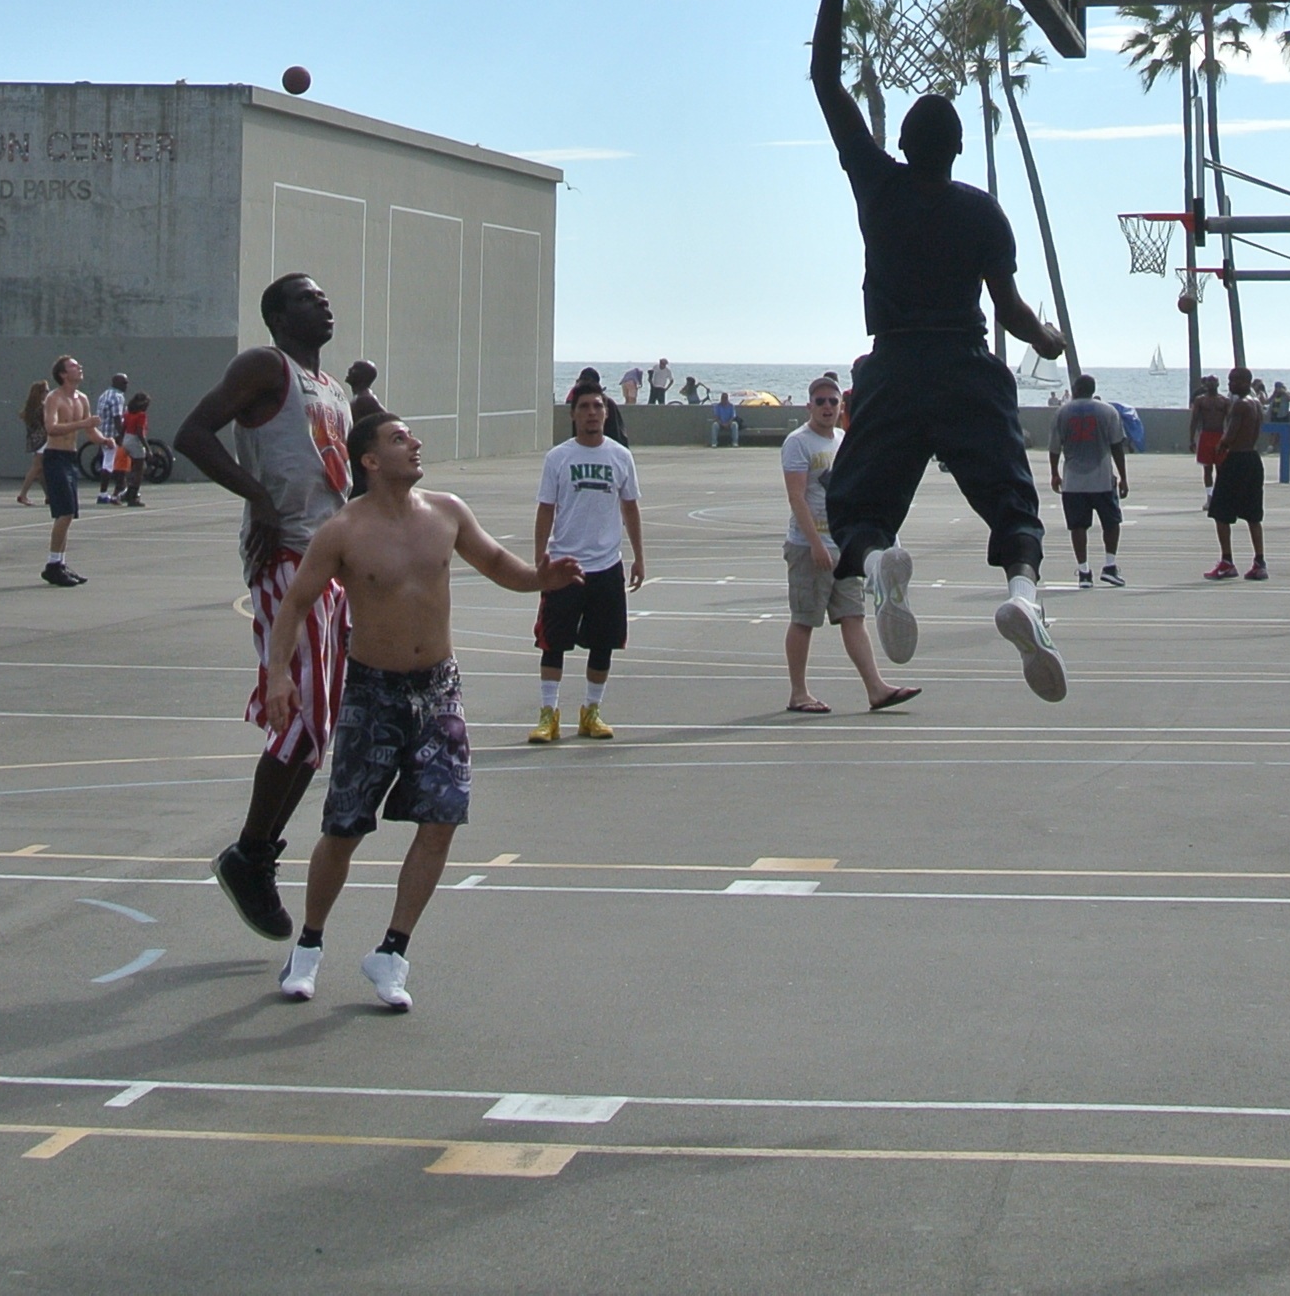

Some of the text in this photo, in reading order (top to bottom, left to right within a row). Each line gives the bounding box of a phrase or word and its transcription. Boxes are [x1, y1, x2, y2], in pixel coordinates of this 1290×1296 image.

[46, 131, 178, 162] CENTER
[23, 179, 93, 201] PARKS
[570, 463, 613, 482] NIKE
